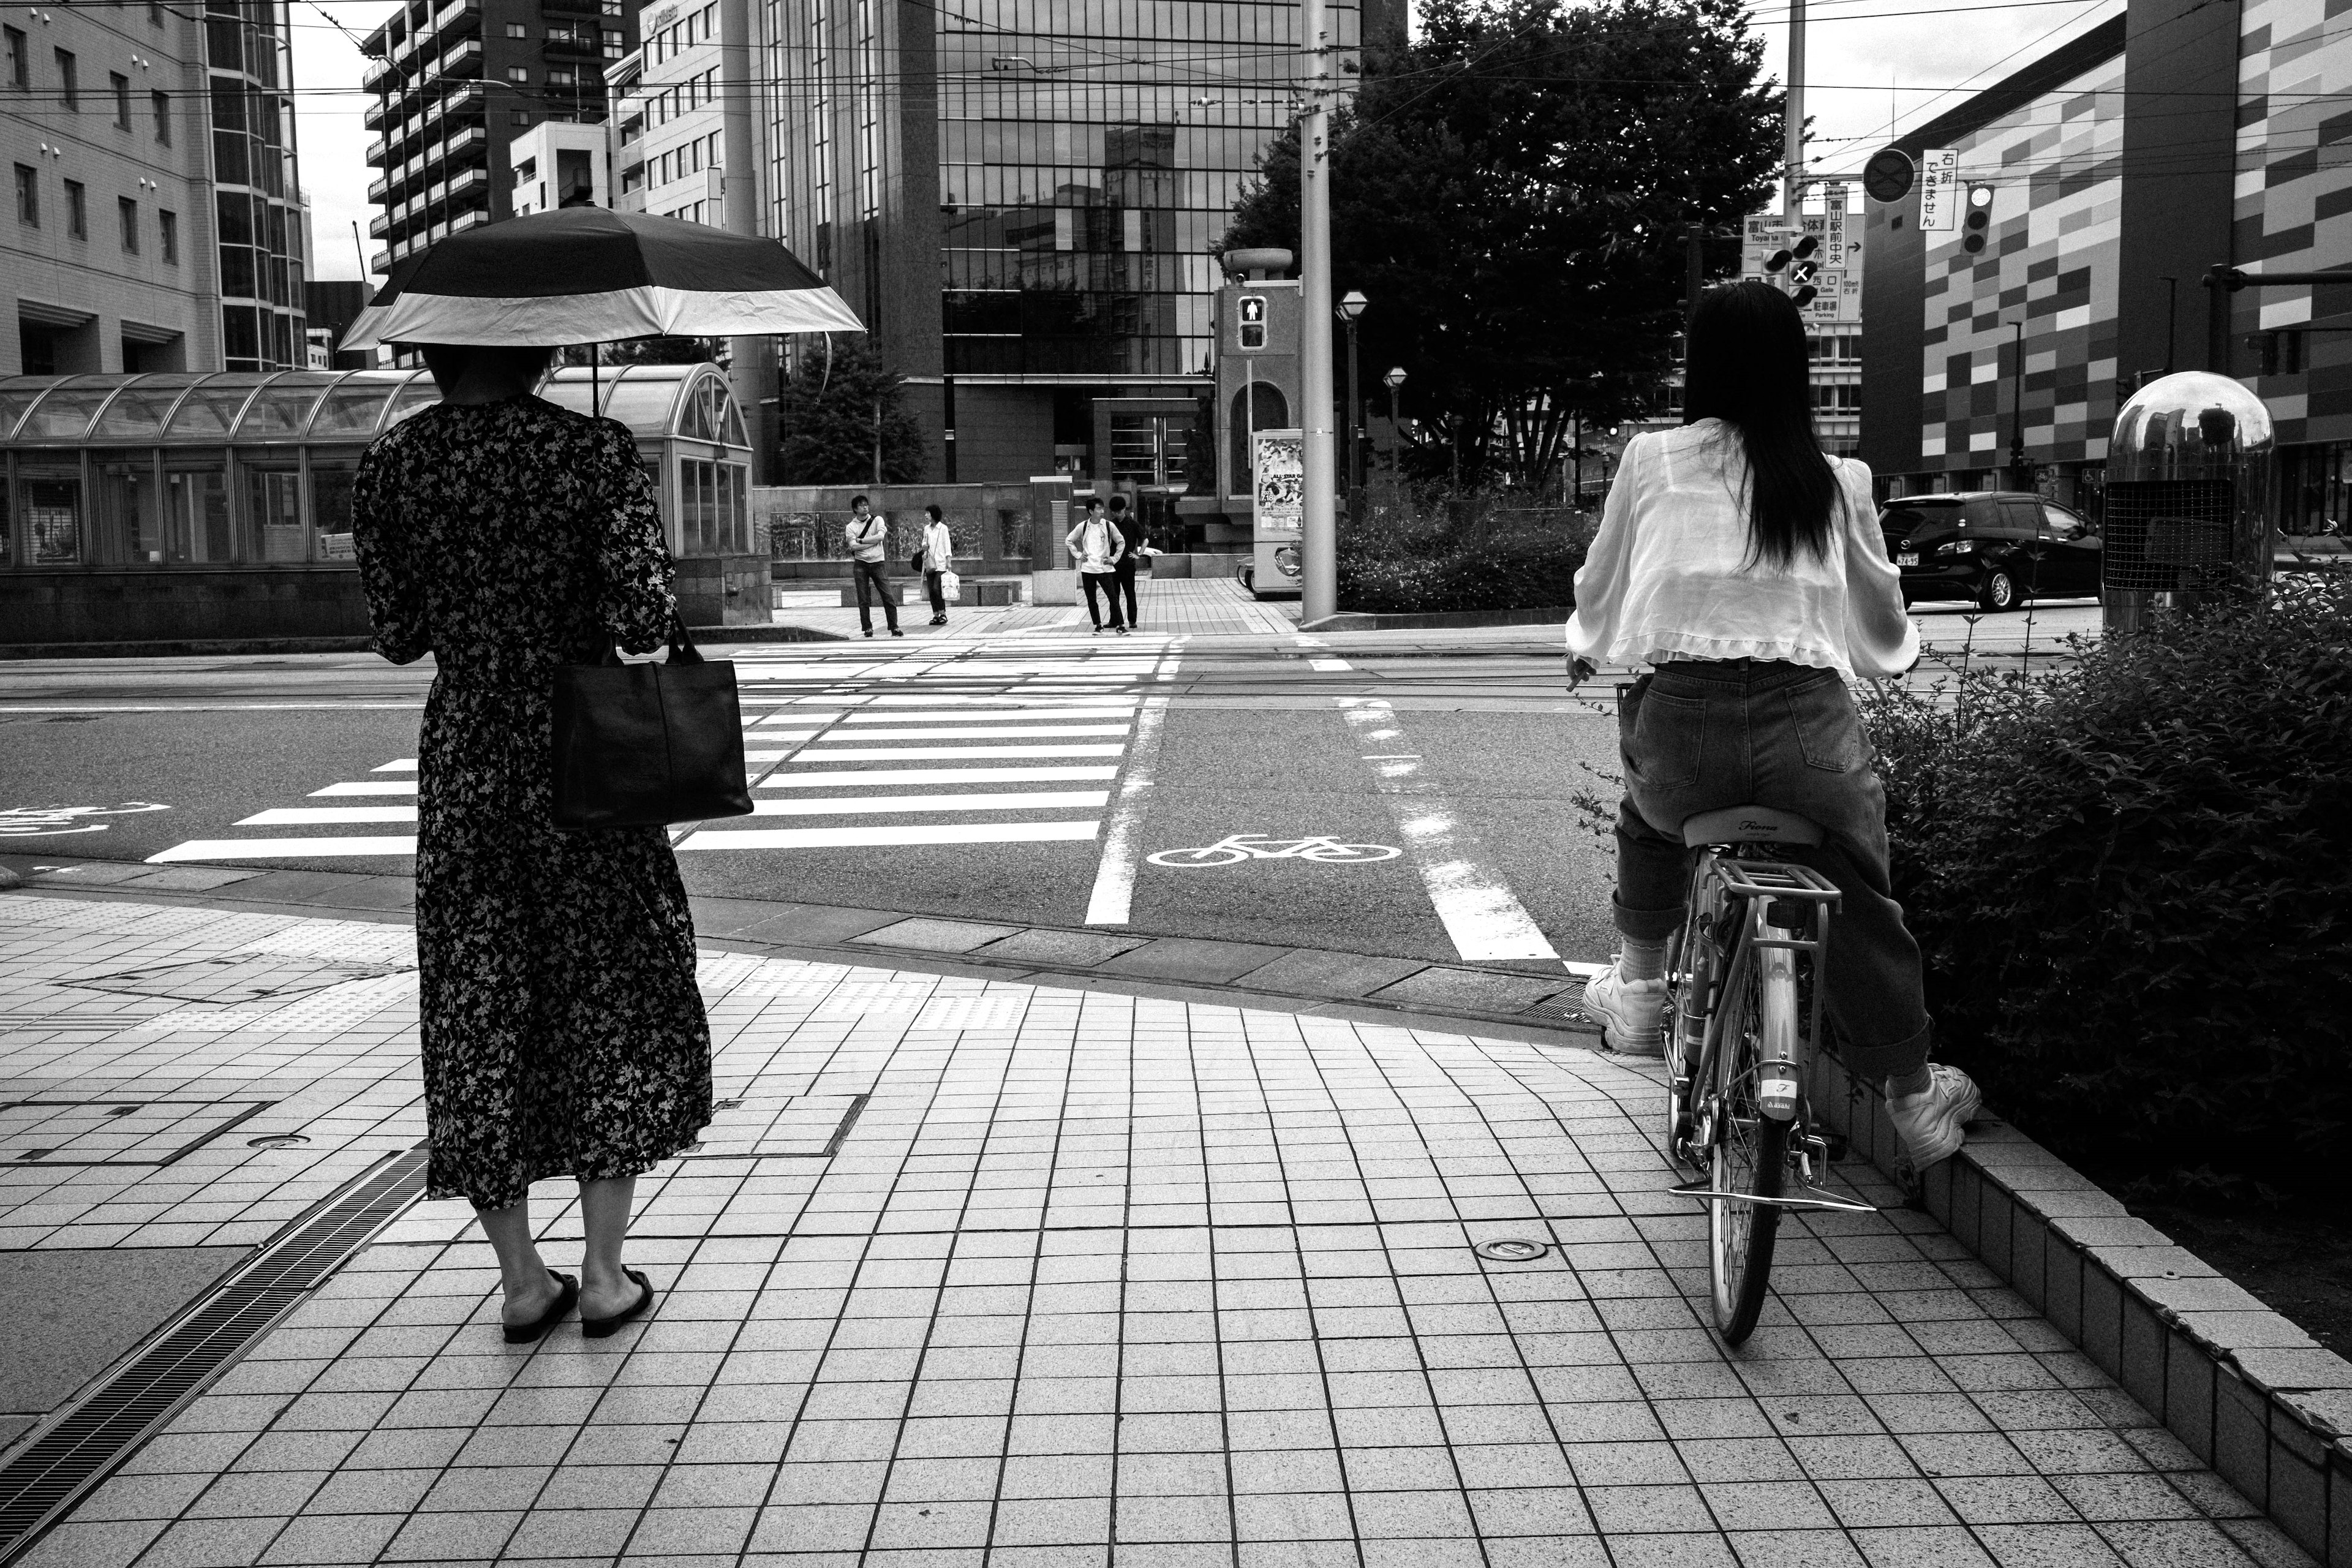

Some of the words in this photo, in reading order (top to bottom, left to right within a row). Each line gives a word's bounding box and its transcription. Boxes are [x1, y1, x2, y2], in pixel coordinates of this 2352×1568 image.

[1941, 153, 1954, 184] 右折
[1923, 162, 1939, 227] できません
[1830, 200, 1842, 264] 富山駅前中央
[1738, 821, 1778, 831] Fiona
